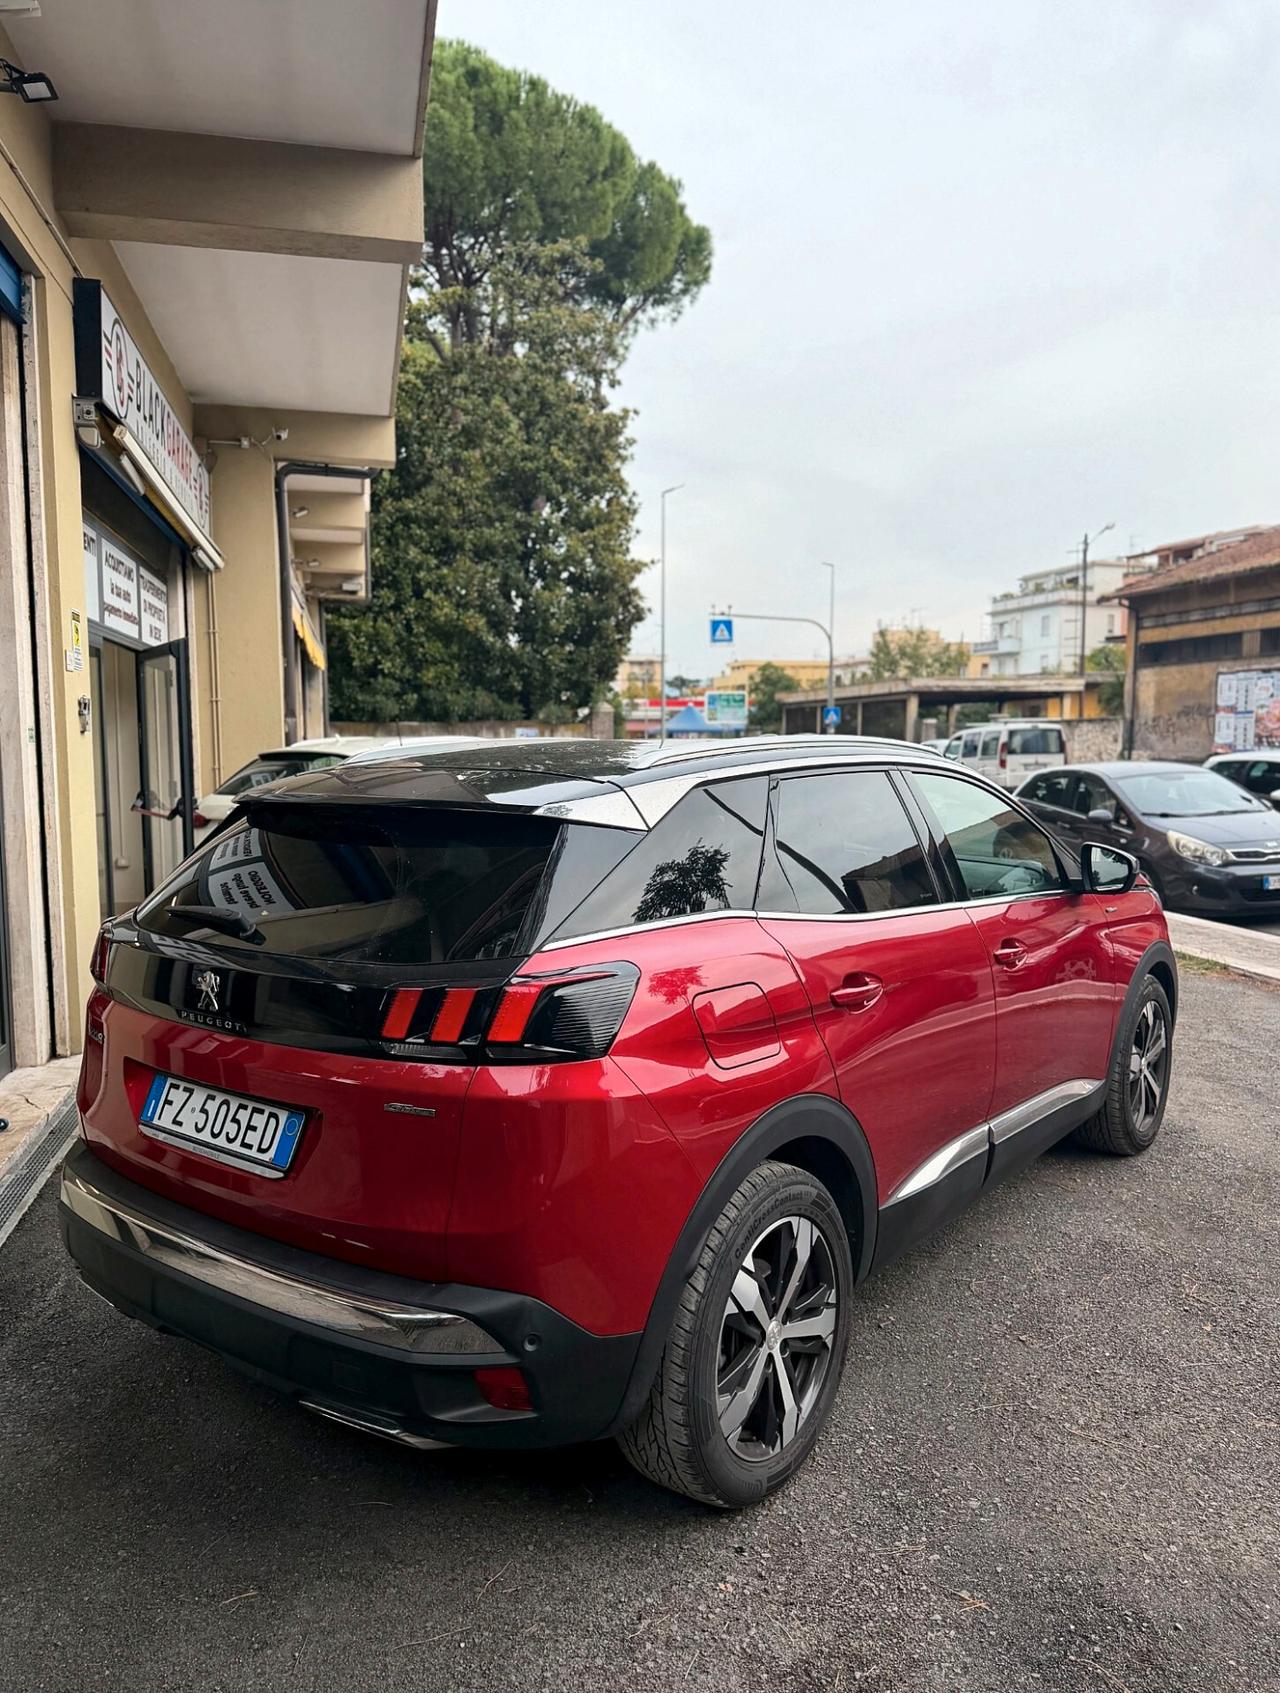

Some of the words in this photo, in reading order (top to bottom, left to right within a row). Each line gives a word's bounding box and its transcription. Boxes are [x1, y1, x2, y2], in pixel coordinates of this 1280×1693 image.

[181, 1011, 242, 1031] PEUGEOT
[157, 1082, 195, 1128] FZ
[194, 1093, 280, 1155] 505ED
